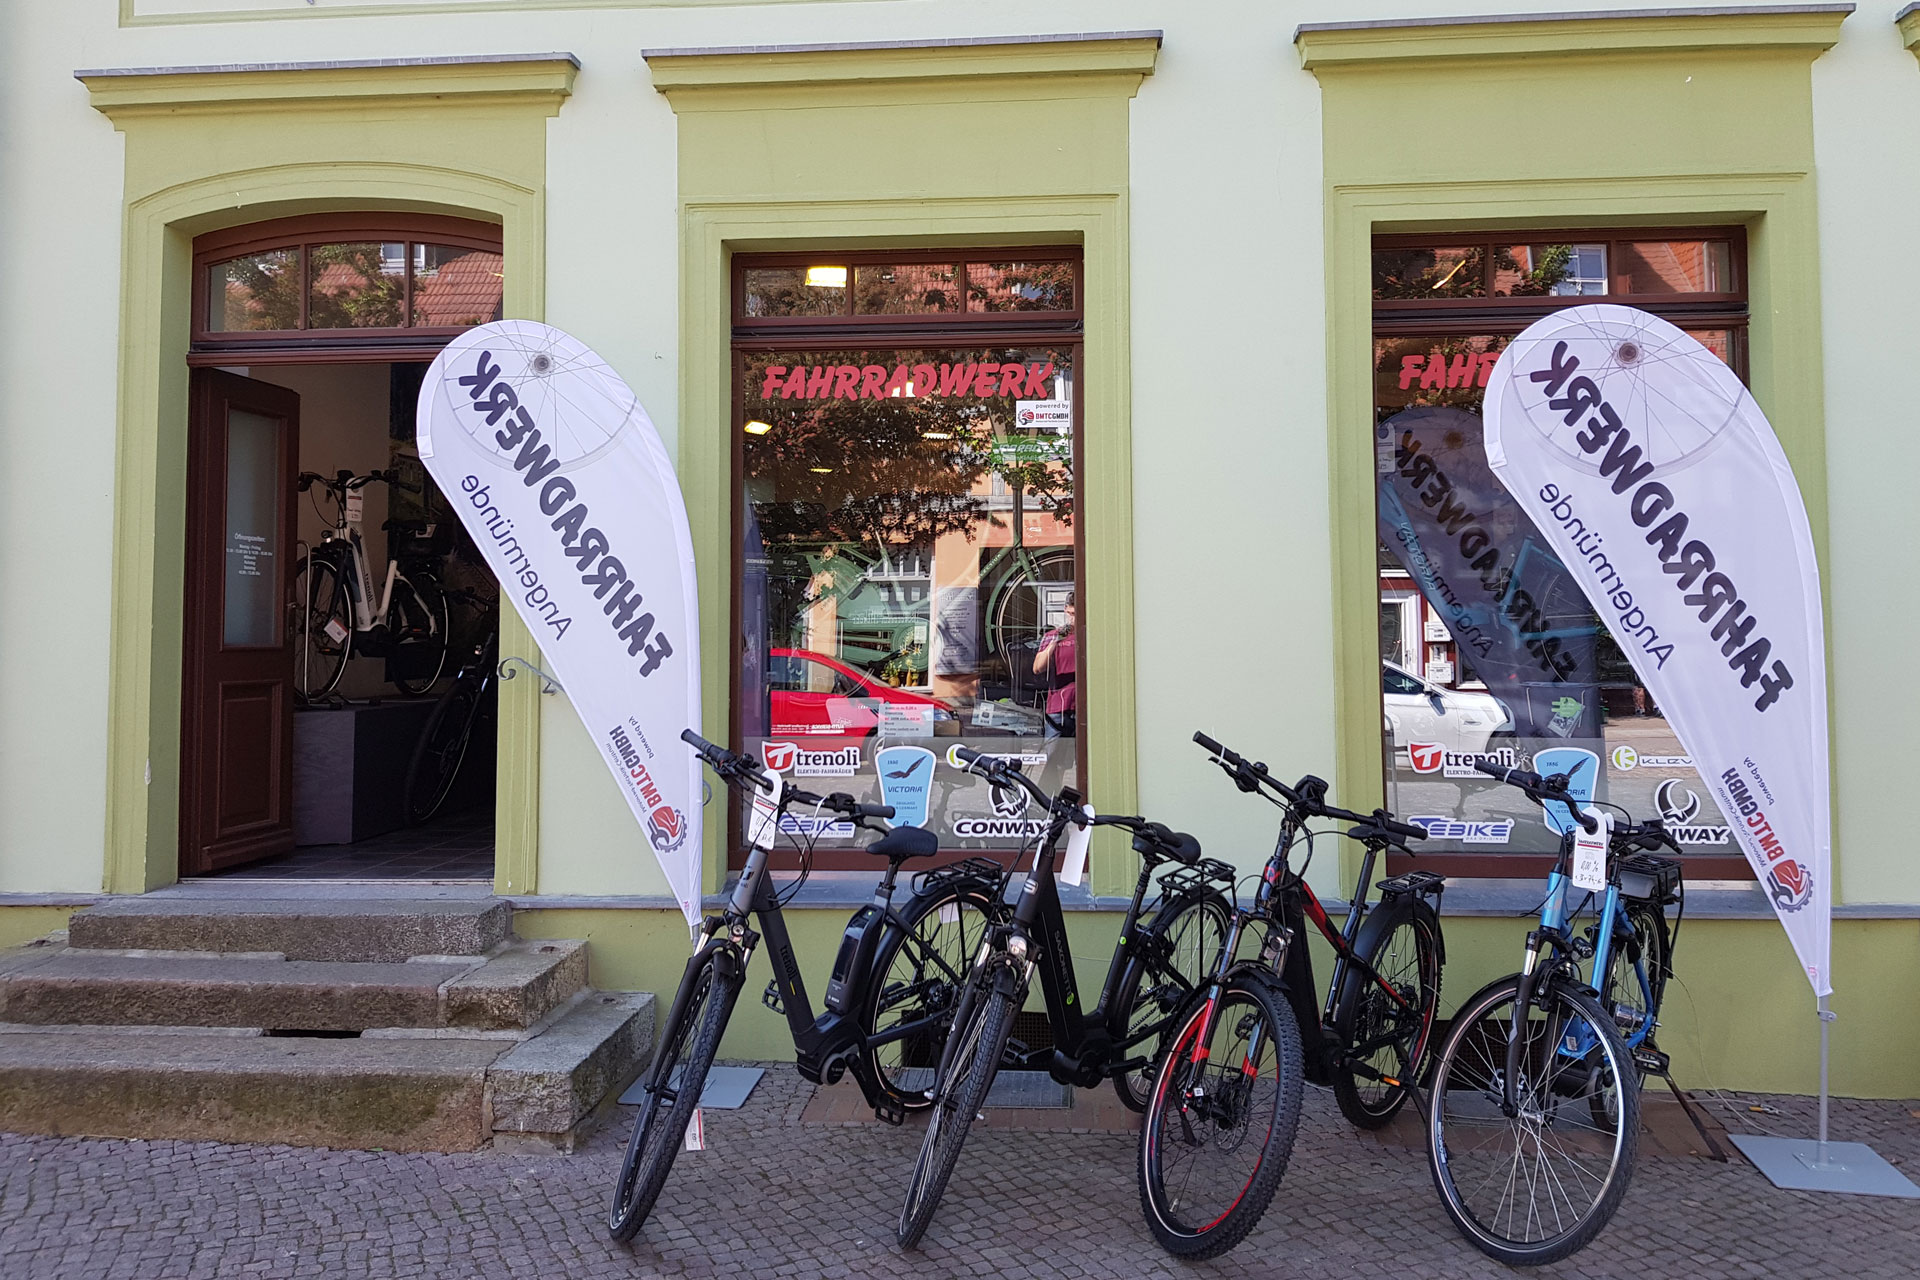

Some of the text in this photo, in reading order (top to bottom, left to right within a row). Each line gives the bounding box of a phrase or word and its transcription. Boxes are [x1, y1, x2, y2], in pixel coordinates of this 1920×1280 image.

[762, 362, 1053, 401] FAHRRADWERK
[796, 749, 858, 766] trenoli
[1429, 824, 1509, 836] EBIKE
[780, 944, 798, 980] trenoli
